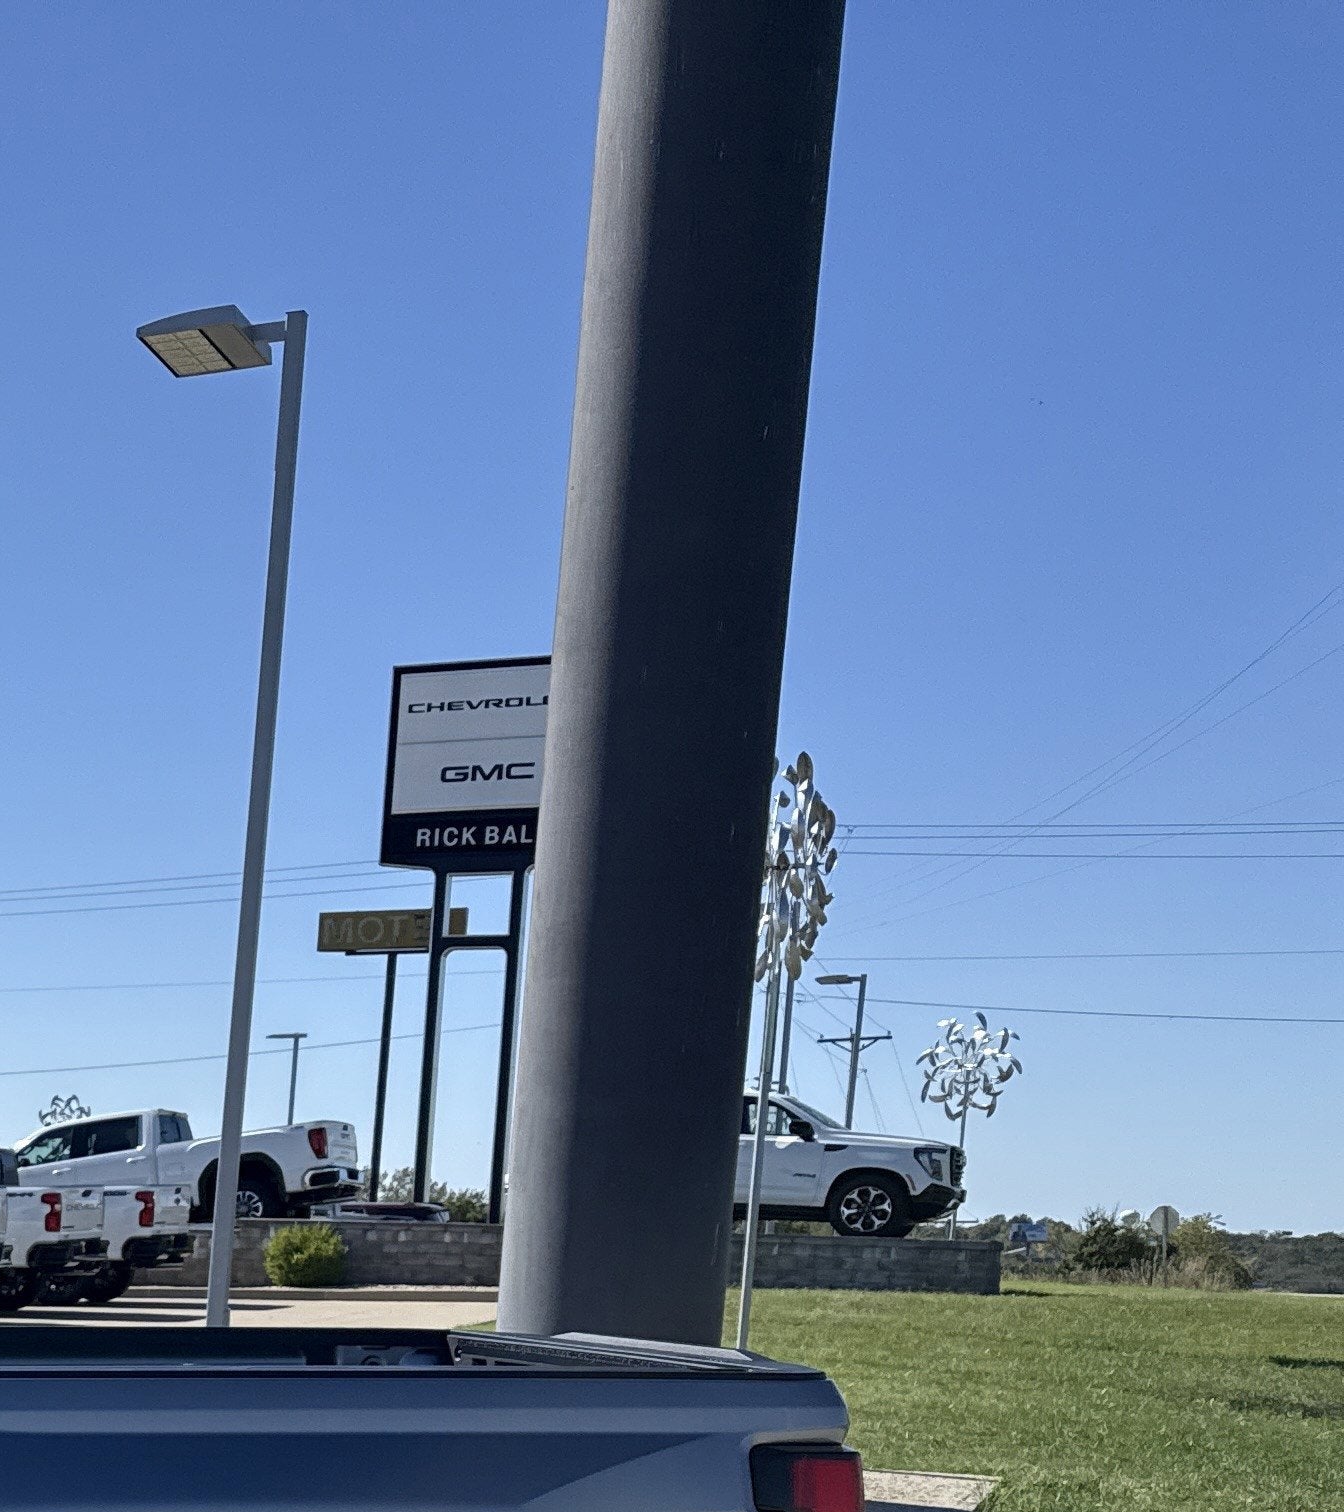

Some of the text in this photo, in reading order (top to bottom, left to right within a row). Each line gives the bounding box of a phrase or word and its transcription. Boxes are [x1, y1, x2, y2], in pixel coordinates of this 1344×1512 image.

[408, 695, 549, 713] CHEVROL
[440, 762, 535, 783] GMC
[416, 824, 534, 847] RICK BAL
[322, 913, 430, 944] MOTE
